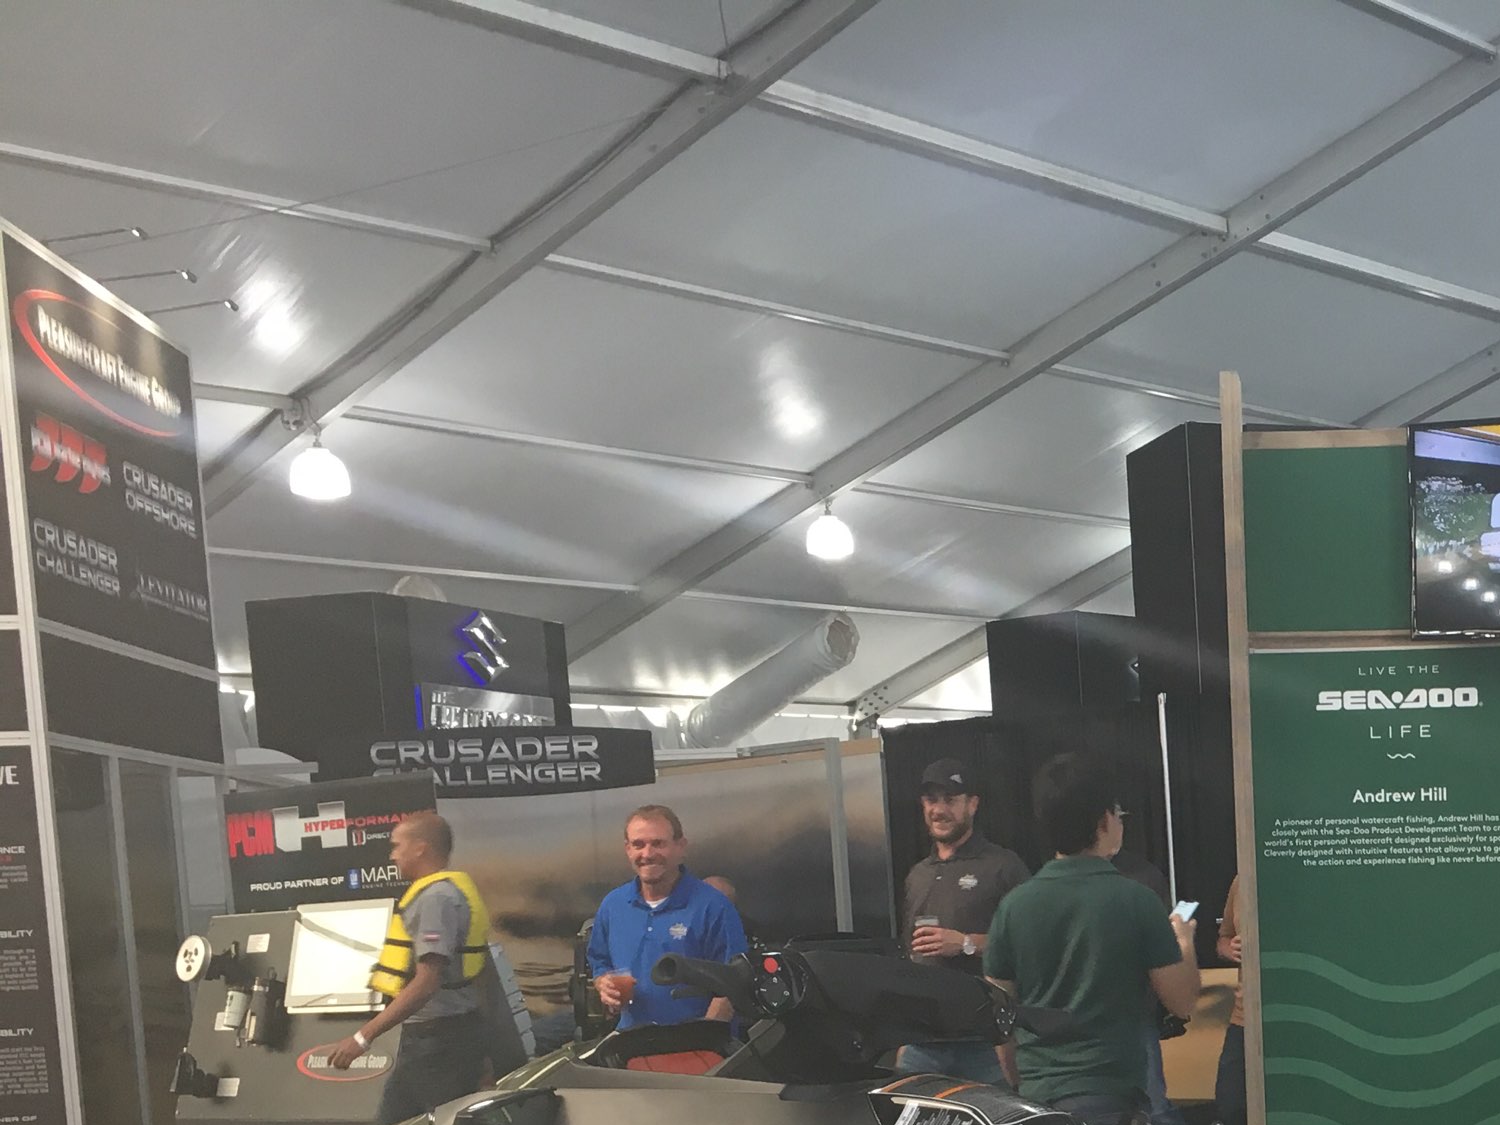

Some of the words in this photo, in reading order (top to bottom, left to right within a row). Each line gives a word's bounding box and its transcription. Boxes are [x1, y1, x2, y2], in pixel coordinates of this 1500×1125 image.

[122, 460, 193, 516] CRUSADER
[125, 488, 197, 540] OFFSHORE
[33, 517, 119, 574] CRUSADER
[35, 551, 121, 598] CHALLENGER
[1358, 666, 1397, 676] LIVE
[1407, 664, 1440, 674] THE
[1370, 724, 1432, 739] LIFE
[369, 734, 601, 766] CRUSADER
[372, 761, 603, 786] ALLENGER
[1352, 788, 1416, 803] Andrew
[1420, 786, 1448, 802] Hill
[1282, 818, 1313, 828] pioneer
[1314, 817, 1323, 825] of
[1325, 816, 1360, 827] personal
[1361, 815, 1404, 825] watercraft
[1406, 814, 1436, 825] fishing,
[1437, 814, 1469, 822] Andrew
[1469, 813, 1484, 822] Hill
[1485, 813, 1500, 821] has
[226, 810, 275, 858] PCM
[1271, 828, 1299, 837] closely
[1300, 828, 1319, 836] with
[1320, 827, 1334, 835] the
[1335, 827, 1370, 835] Sea-Doo
[1371, 826, 1403, 834] Product
[1404, 824, 1457, 834] Development
[1459, 824, 1481, 832] Team
[1482, 824, 1492, 832] to
[1264, 838, 1294, 847] world's
[1295, 838, 1312, 846] first
[1313, 837, 1348, 847] personal
[1349, 836, 1393, 845] watercraft
[1394, 835, 1430, 846] designed
[1431, 834, 1474, 844] exclusively
[1475, 834, 1487, 842] for
[1263, 848, 1296, 858] Cleverly
[1297, 847, 1334, 858] designed
[1335, 847, 1354, 855] with
[1354, 846, 1388, 855] intuitive
[1389, 846, 1423, 854] features
[1424, 845, 1442, 853] that
[1443, 845, 1465, 853] allow
[1466, 845, 1482, 854] you
[1303, 858, 1317, 866] the
[1318, 858, 1344, 866] action
[1345, 857, 1362, 865] and
[1363, 856, 1406, 866] experience
[1407, 855, 1436, 865] fishing
[1436, 855, 1451, 863] like
[1452, 855, 1475, 863] never
[250, 881, 283, 892] PROUD
[284, 876, 329, 890] PARTNER
[330, 875, 345, 886] OF
